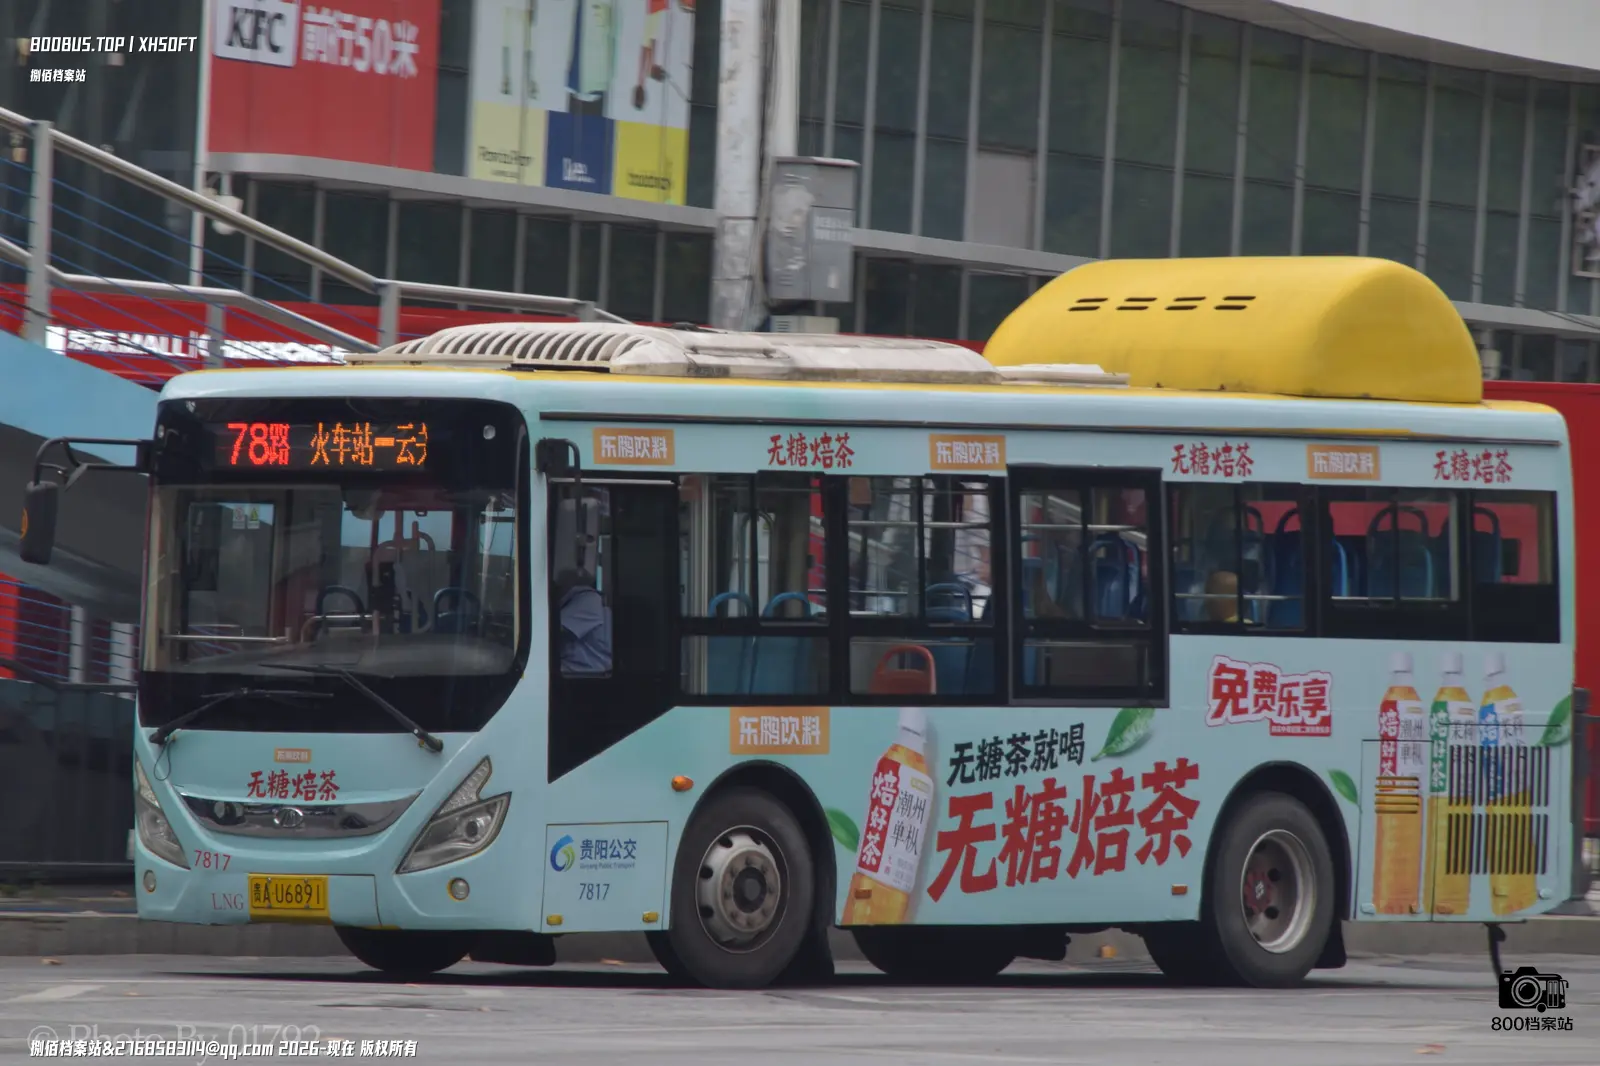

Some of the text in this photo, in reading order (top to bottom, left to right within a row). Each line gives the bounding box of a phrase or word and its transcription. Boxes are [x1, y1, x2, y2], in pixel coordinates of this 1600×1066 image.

[225, 6, 286, 53] KFC
[301, 6, 419, 78] 前行50米
[228, 423, 290, 465] 78路
[600, 434, 668, 459] 东鹏饮料
[767, 432, 855, 469] 无糖焙茶
[936, 440, 1000, 465] 东鹏饮料
[1170, 441, 1255, 477] 无糖焙茶
[1312, 451, 1374, 474] 东鹏饮料
[1433, 448, 1513, 484] 无糖焙茶
[1210, 662, 1328, 719] 免费乐享
[739, 715, 821, 746] 东鹏饮料
[946, 722, 1085, 787] 无糖茶就喝
[247, 769, 340, 802] 无糖焙茶
[861, 770, 899, 866] 焙好茶
[927, 757, 1200, 903] 无糖焙茶
[194, 850, 231, 871] 7817
[580, 838, 637, 860] 贵阳公交
[211, 893, 244, 910] LNG
[579, 883, 610, 900] 7817
